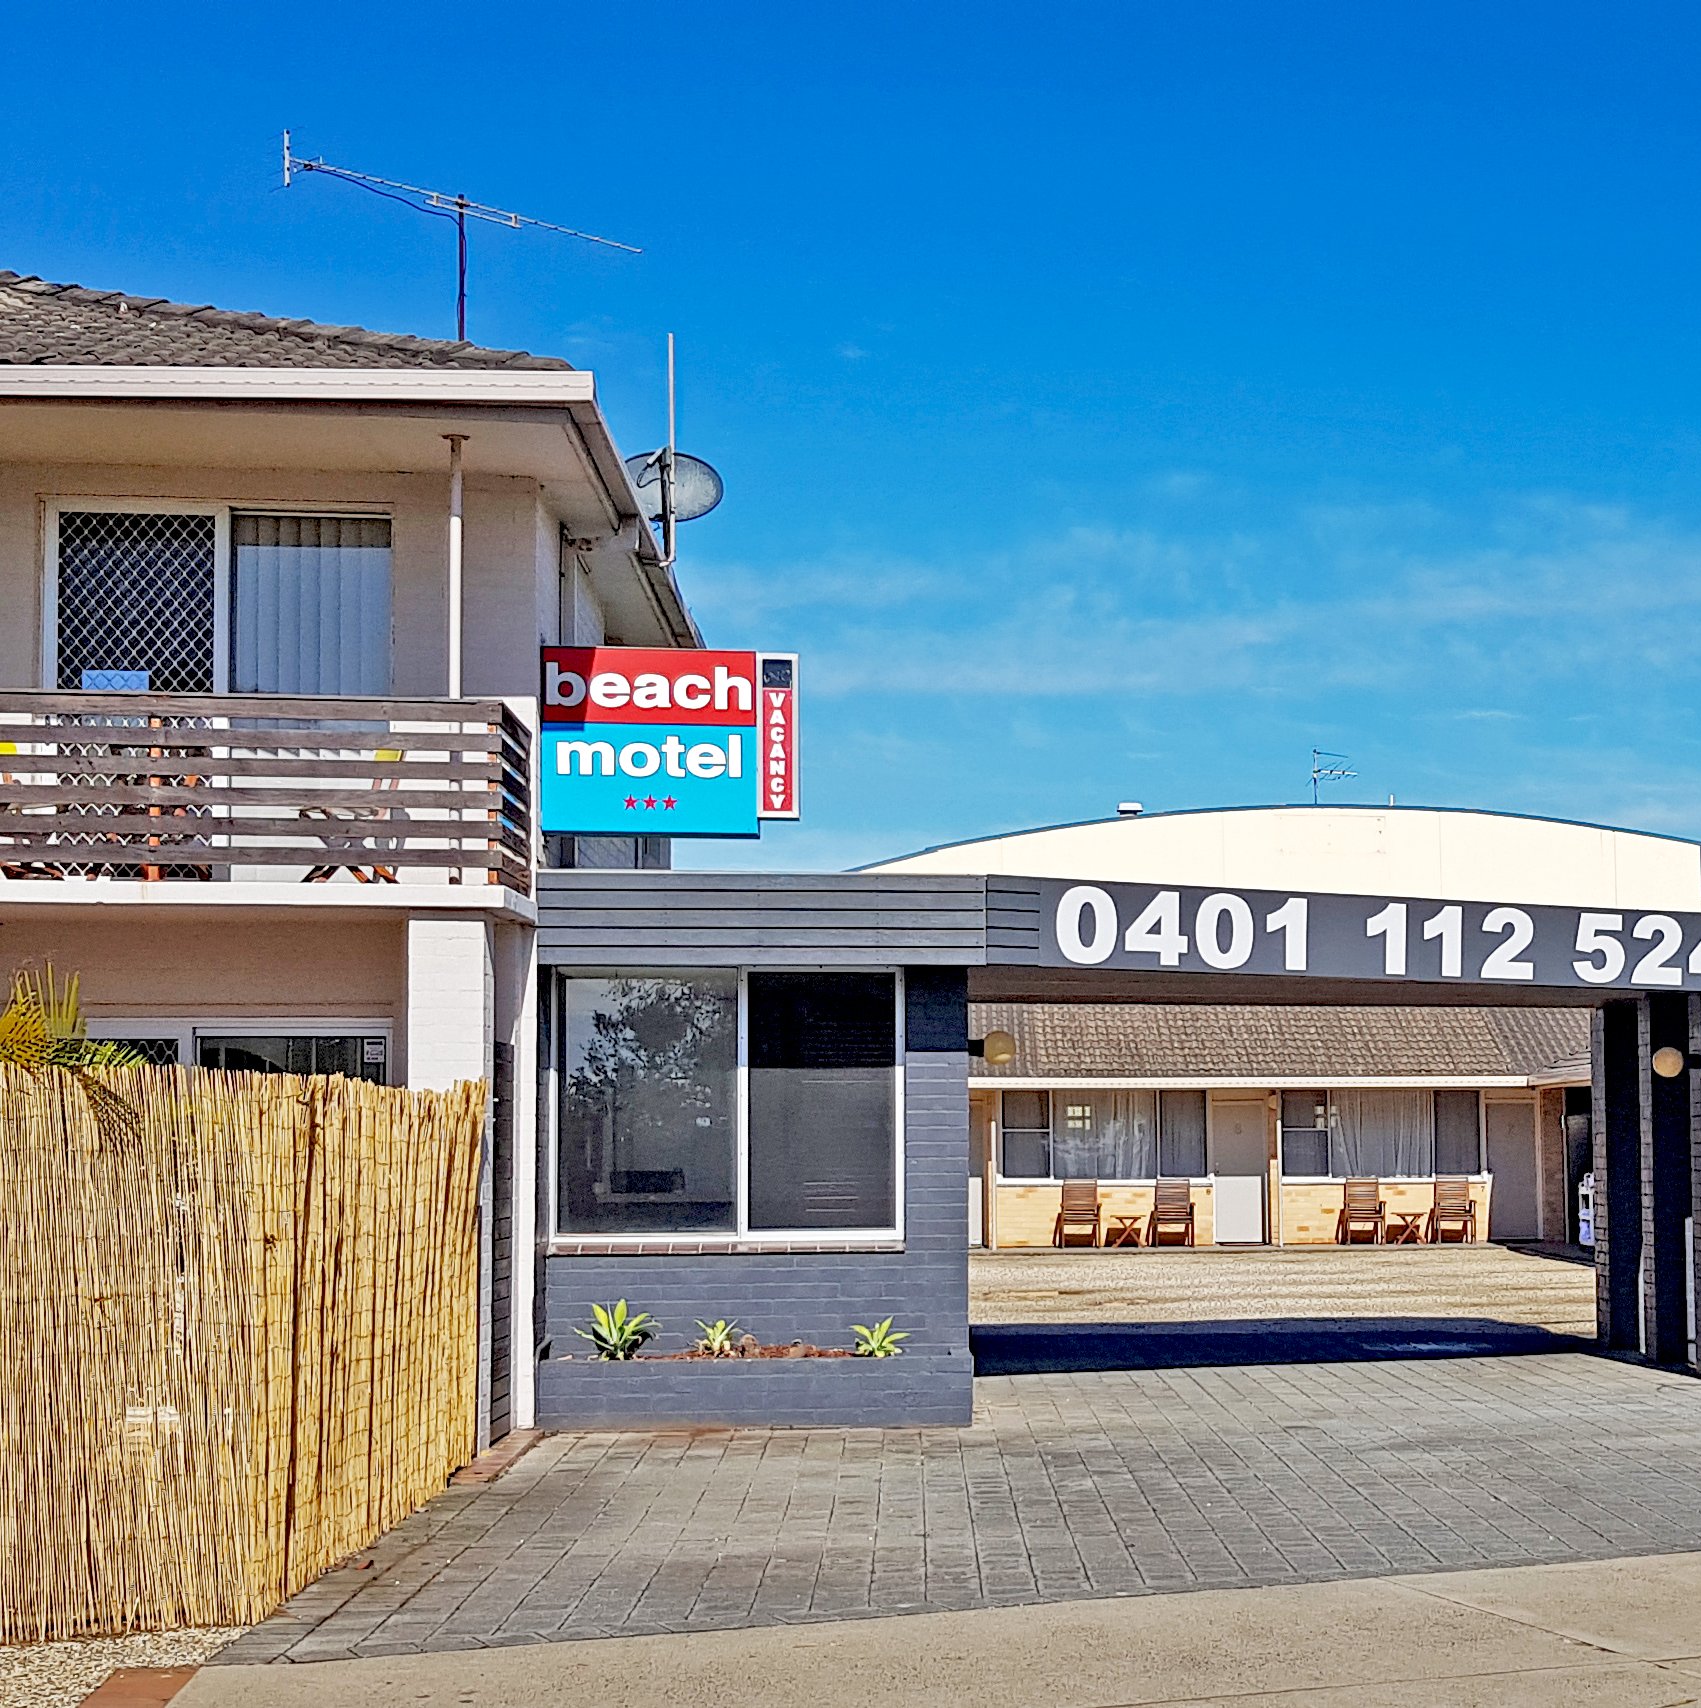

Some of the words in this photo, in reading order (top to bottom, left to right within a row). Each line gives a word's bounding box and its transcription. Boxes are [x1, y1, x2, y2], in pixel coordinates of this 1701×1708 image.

[545, 661, 752, 711] beach
[556, 734, 742, 778] motel
[768, 692, 787, 809] VACANCY
[1055, 885, 1308, 971] 0401
[1366, 902, 1534, 981] 112
